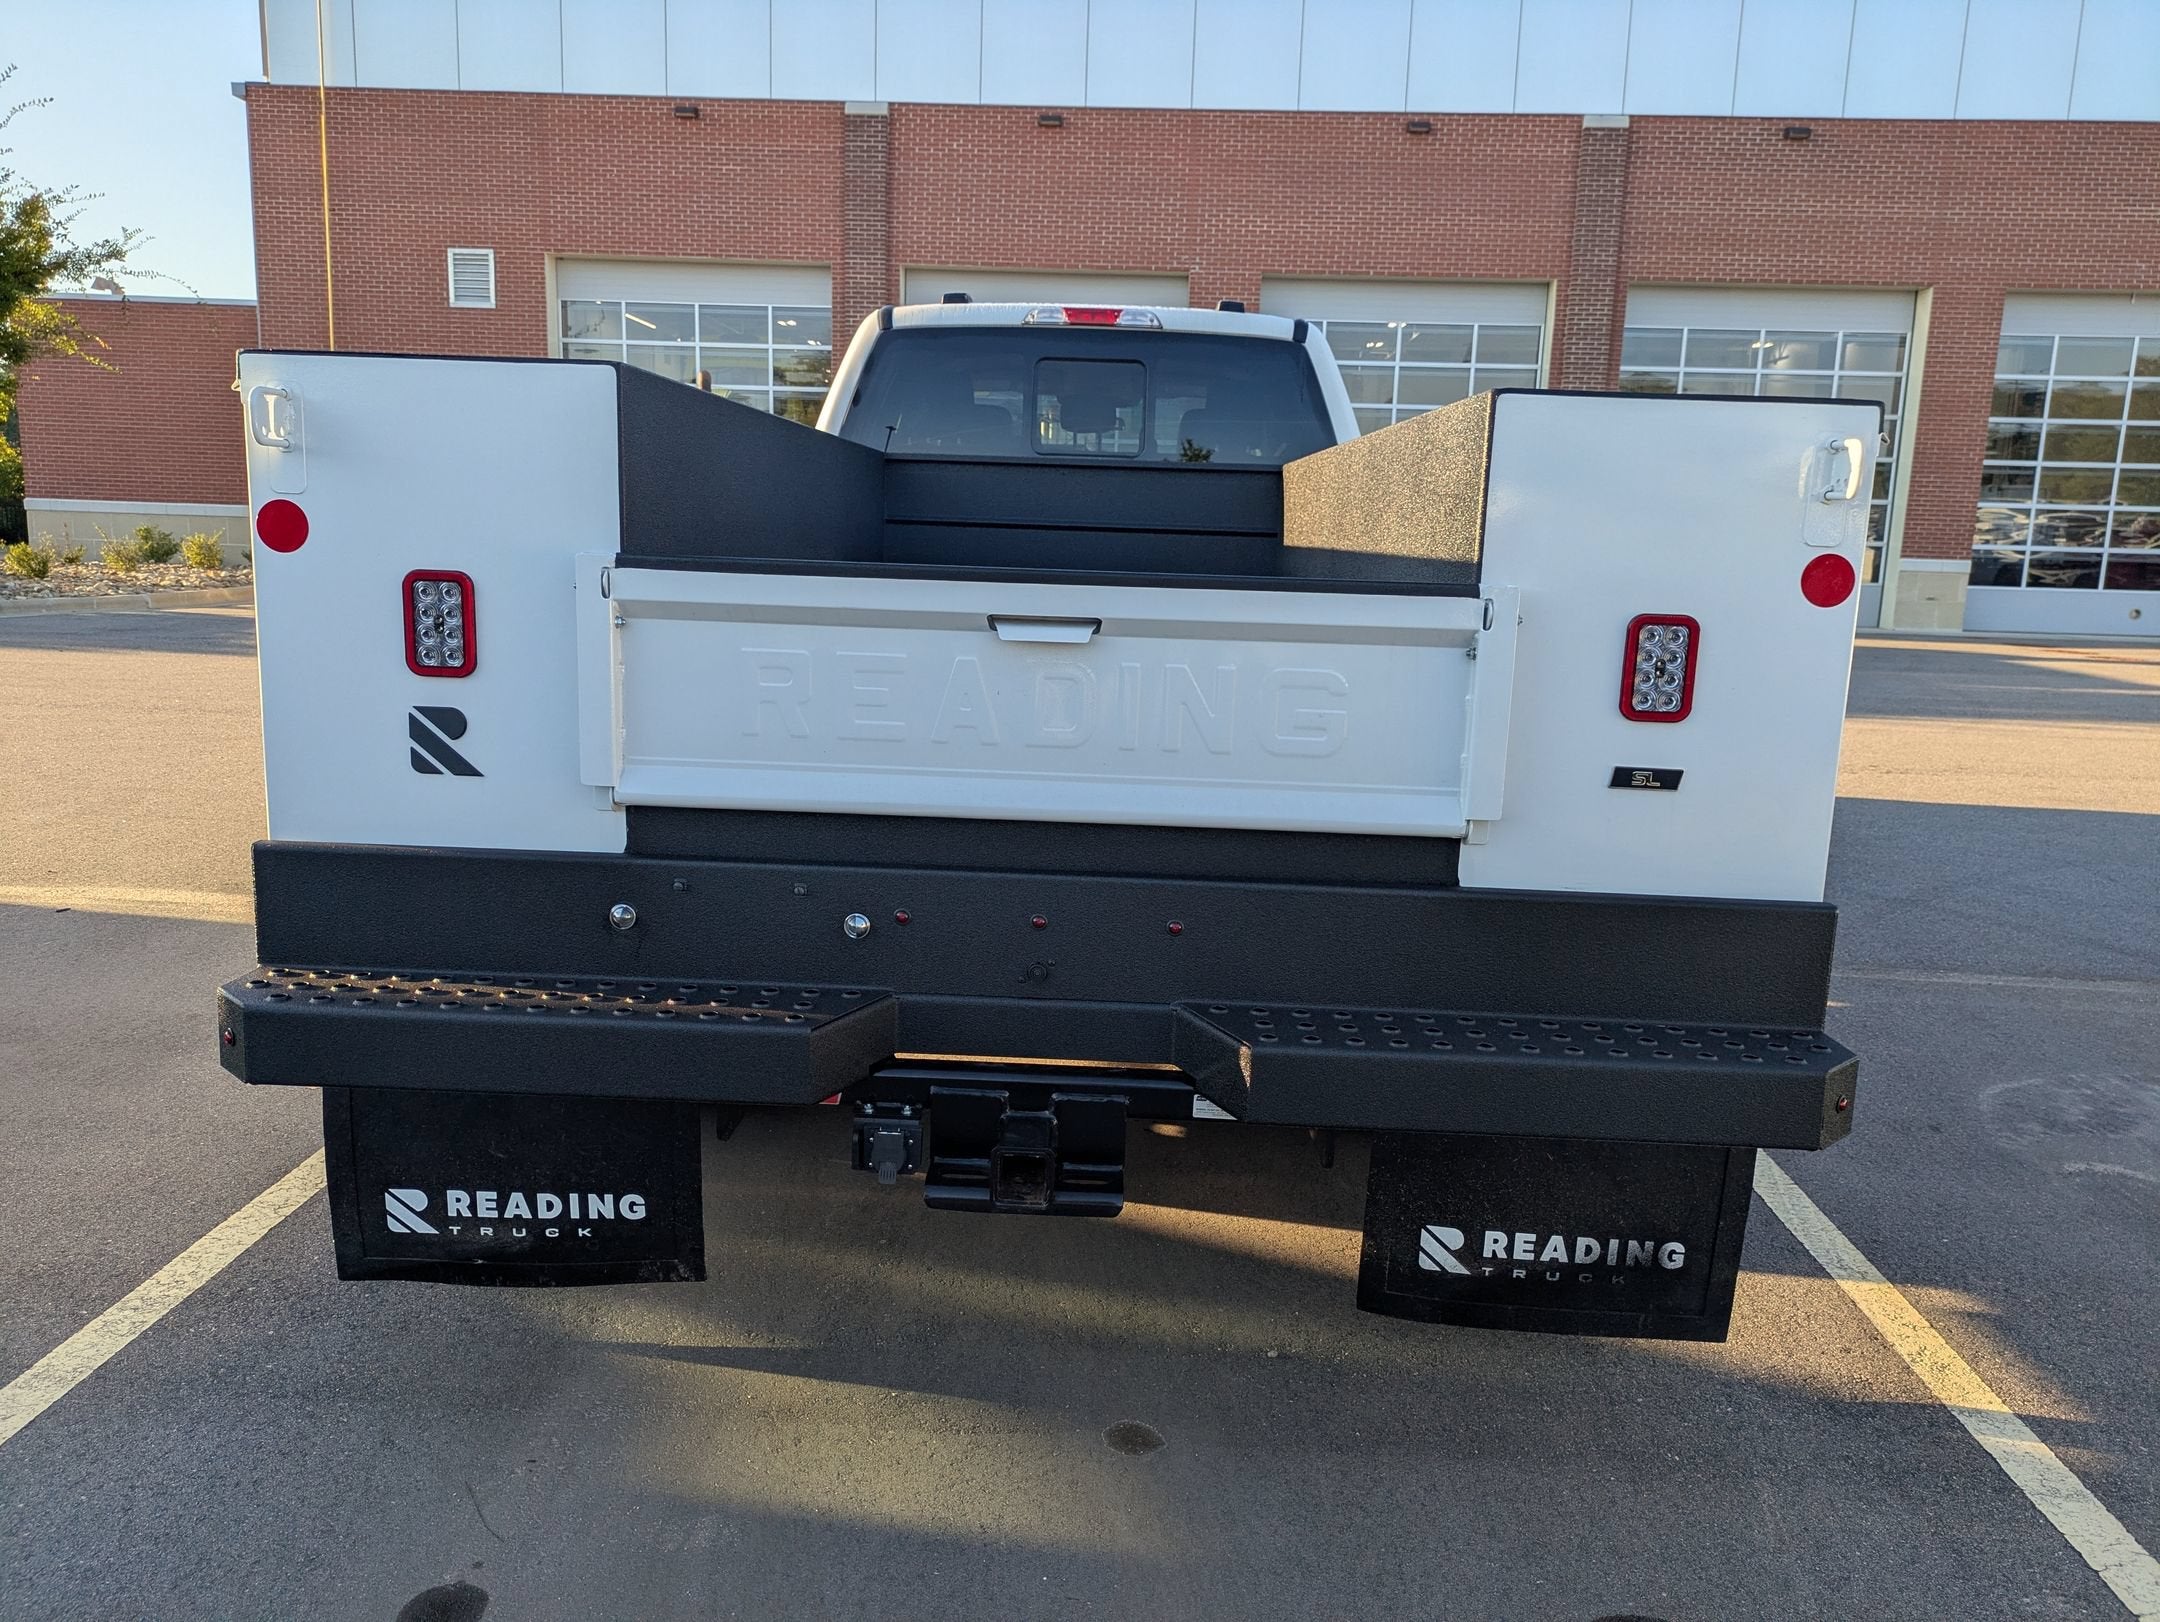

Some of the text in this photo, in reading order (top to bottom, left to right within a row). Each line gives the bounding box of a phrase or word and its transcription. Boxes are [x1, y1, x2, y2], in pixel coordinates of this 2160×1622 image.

[740, 647, 1349, 759] READING
[1631, 771, 1661, 787] SL
[446, 1189, 647, 1221] READING
[449, 1226, 593, 1238] TRUCK
[1482, 1230, 1687, 1270] READING
[1481, 1267, 1625, 1285] TRUCK
